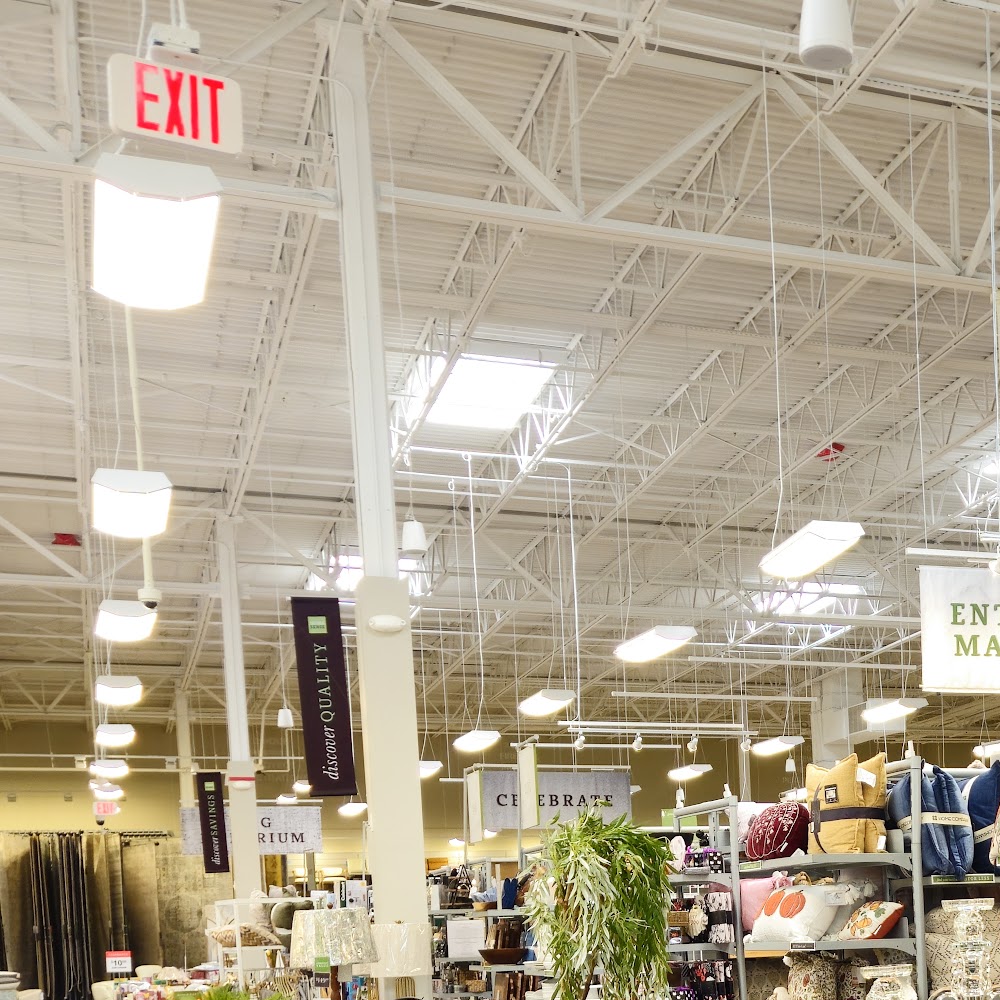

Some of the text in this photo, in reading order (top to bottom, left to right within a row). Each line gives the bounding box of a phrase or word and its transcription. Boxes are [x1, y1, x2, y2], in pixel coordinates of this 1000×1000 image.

[134, 61, 225, 145] EXIT
[313, 642, 340, 780] discover QUALITY
[207, 794, 218, 836] SAVINGS
[496, 793, 614, 807] CEEBRATE
